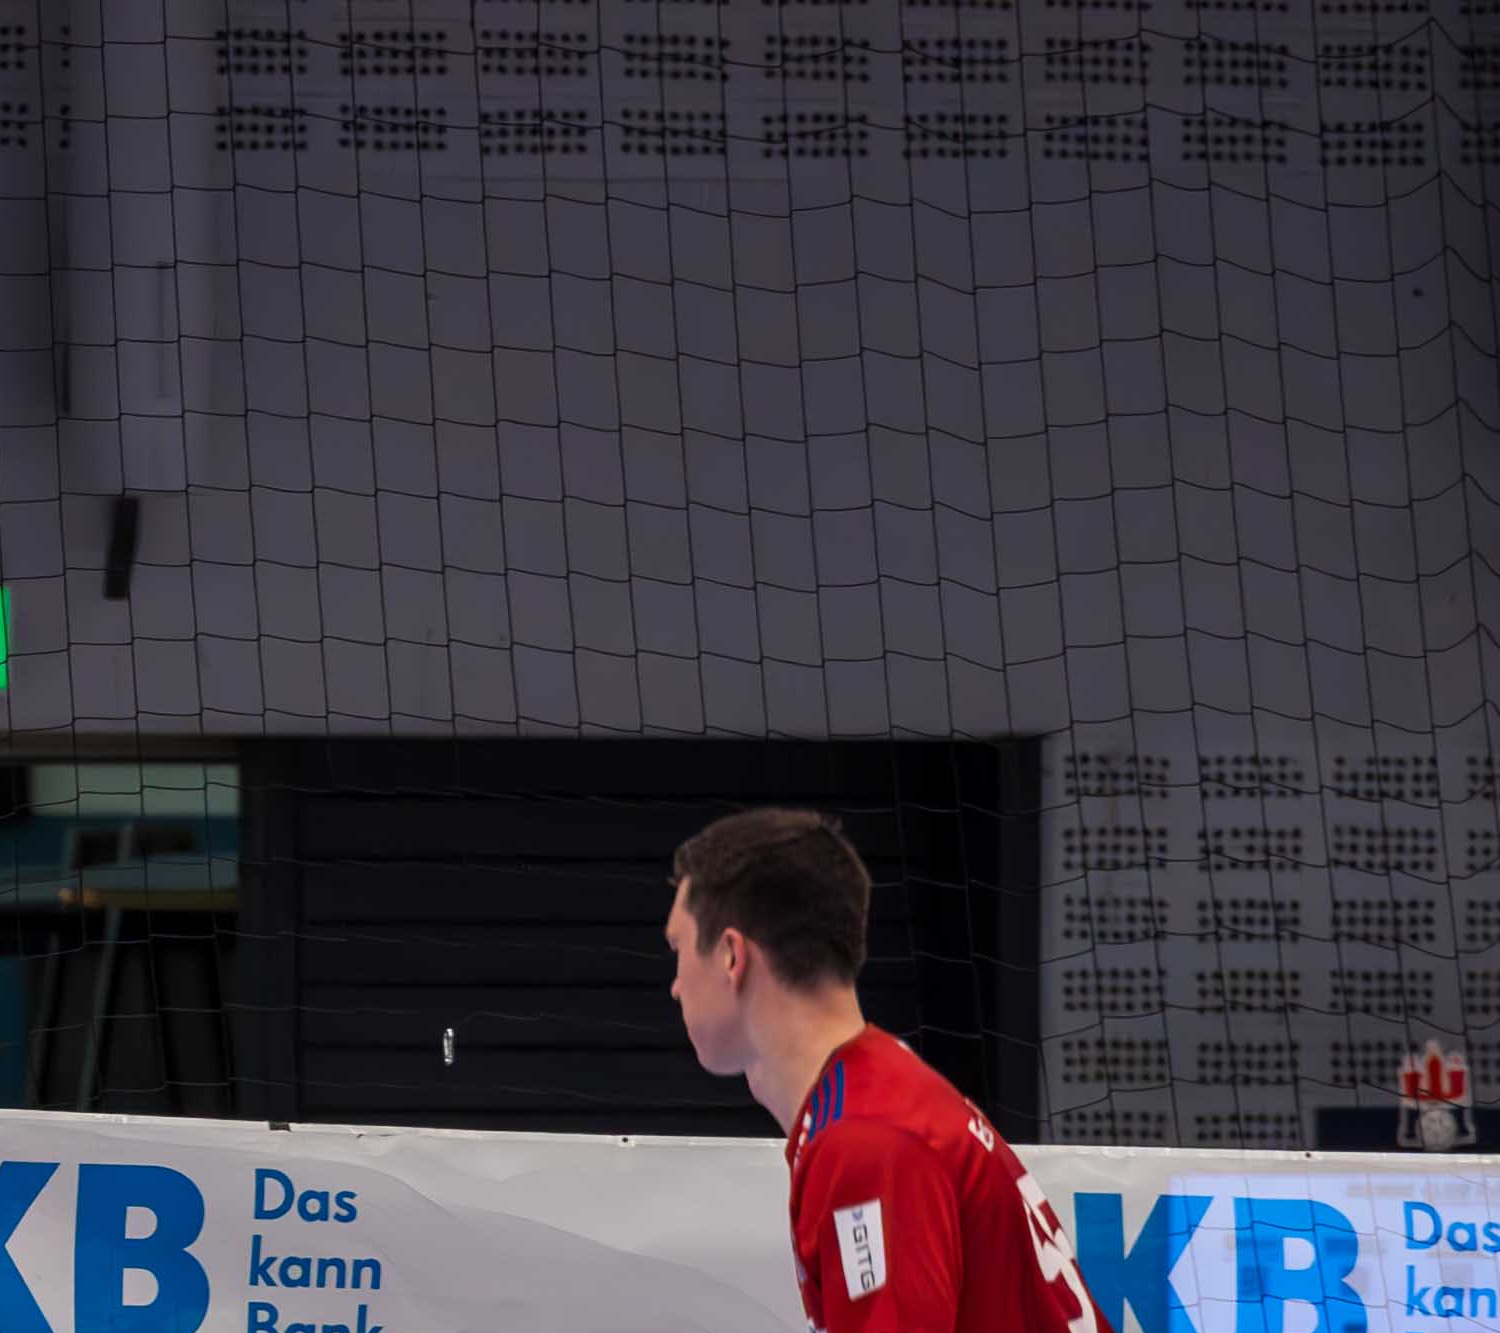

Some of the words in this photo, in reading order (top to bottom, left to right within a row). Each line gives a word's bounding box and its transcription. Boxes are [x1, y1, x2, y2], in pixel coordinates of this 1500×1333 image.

[253, 1168, 358, 1225] Das
[1403, 1201, 1500, 1253] Das
[248, 1234, 382, 1291] kann
[1406, 1264, 1500, 1318] kan
